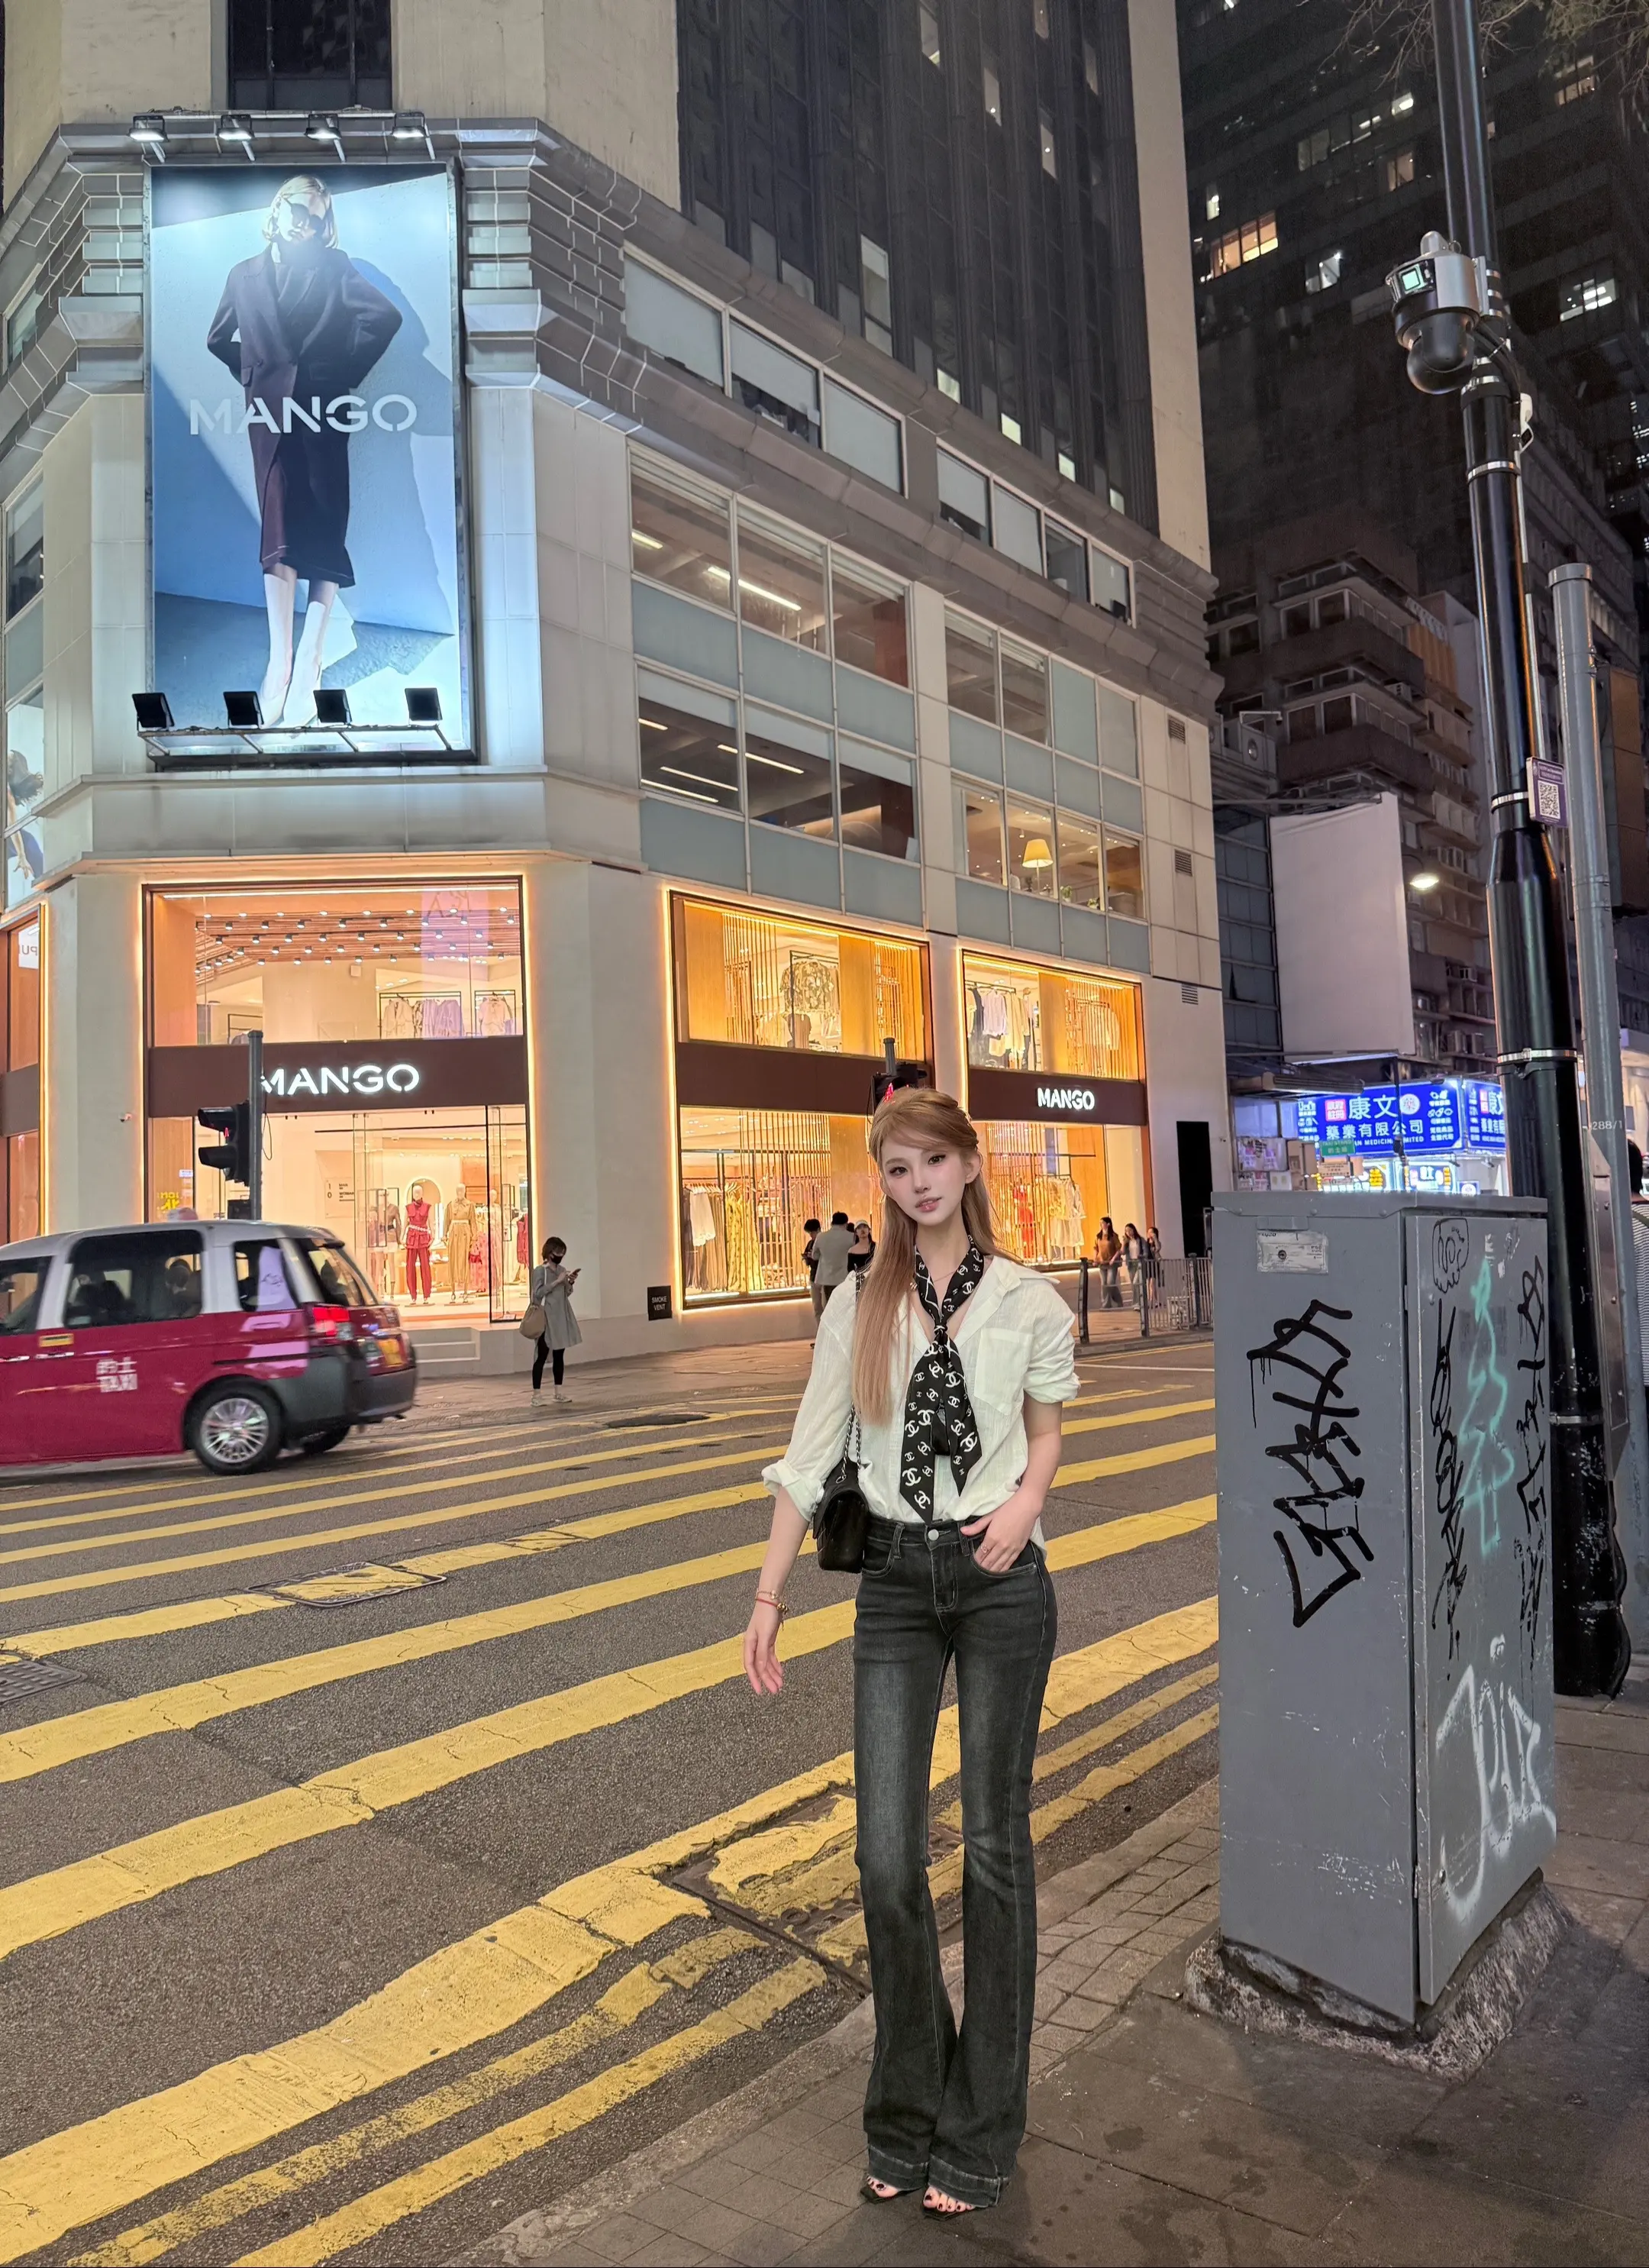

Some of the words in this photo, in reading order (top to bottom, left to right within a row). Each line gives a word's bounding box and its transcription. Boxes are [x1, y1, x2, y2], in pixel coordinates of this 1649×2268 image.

[190, 394, 418, 435] MANGO
[1037, 1087, 1095, 1110] MANGO
[1348, 1094, 1399, 1119] 康文
